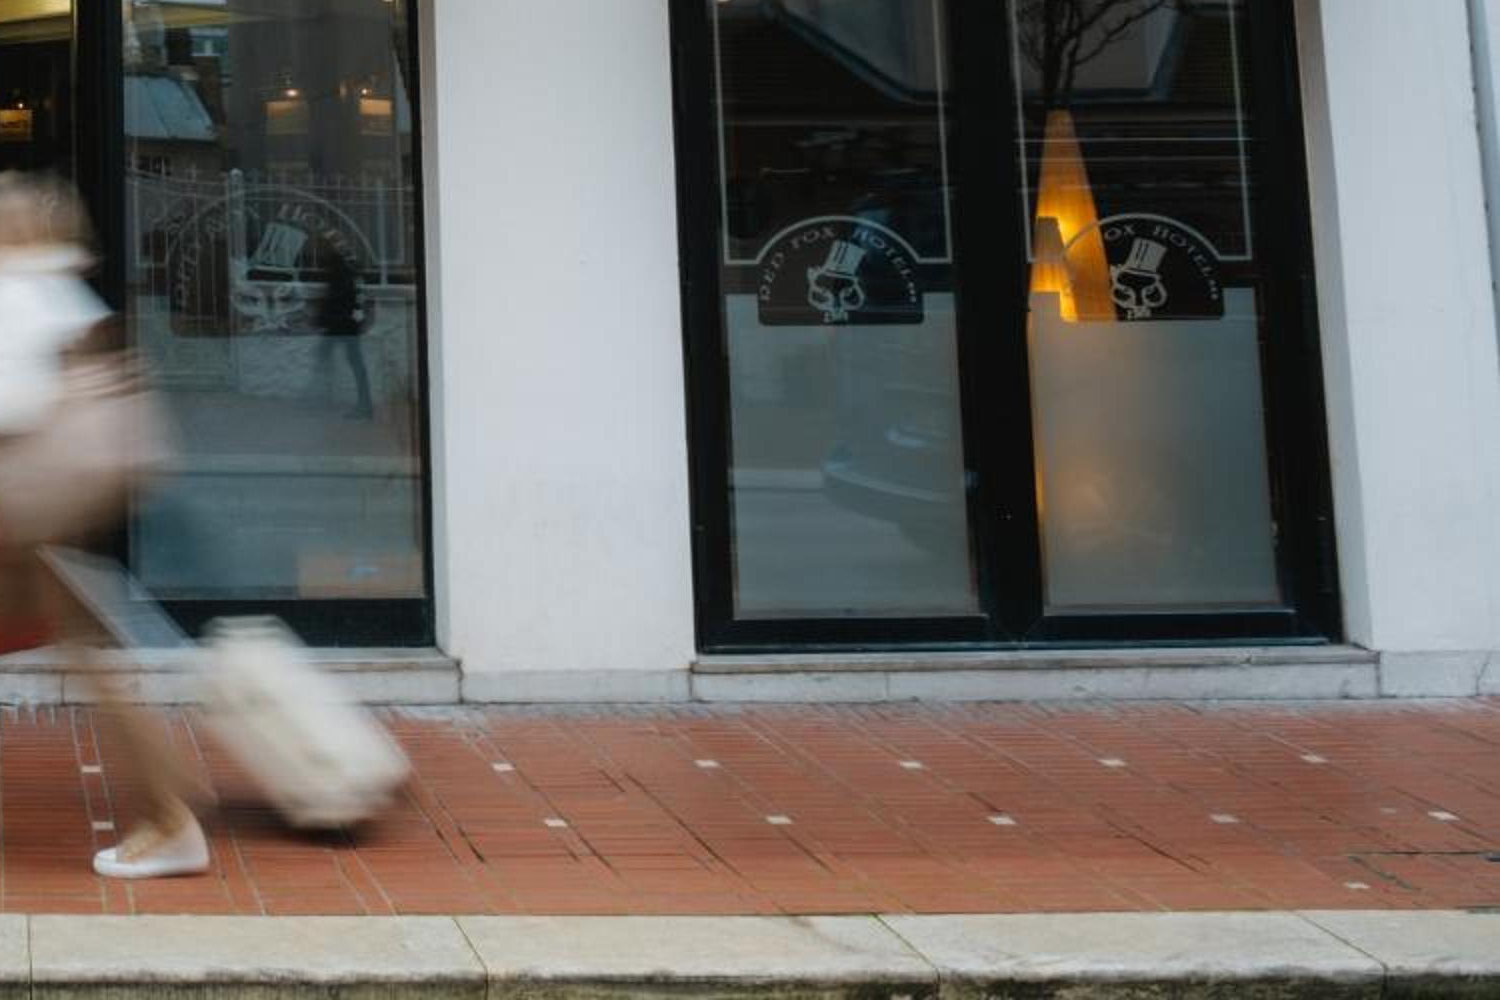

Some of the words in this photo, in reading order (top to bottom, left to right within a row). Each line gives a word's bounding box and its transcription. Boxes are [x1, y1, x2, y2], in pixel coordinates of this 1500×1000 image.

[789, 226, 837, 249] FOX
[852, 226, 912, 277] HOTEL
[1152, 225, 1213, 277] HOTEL
